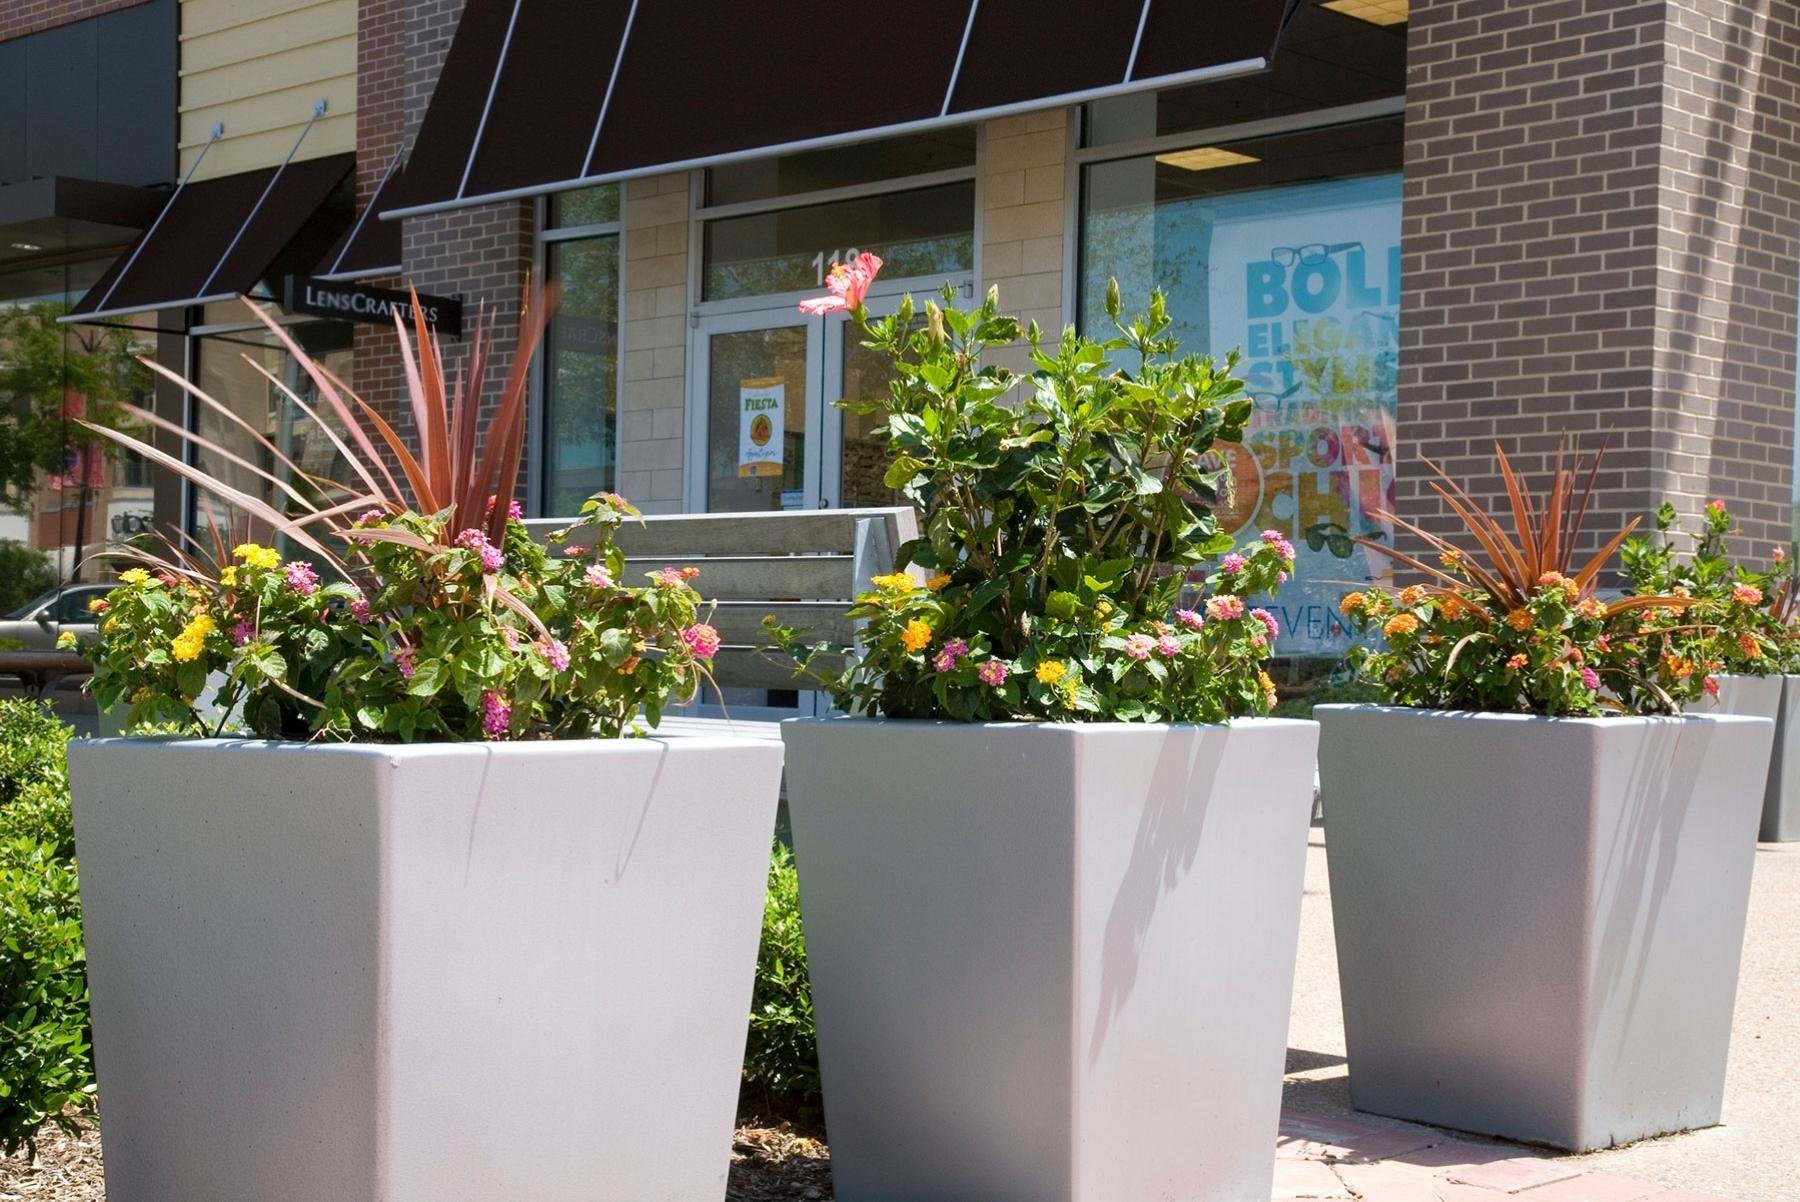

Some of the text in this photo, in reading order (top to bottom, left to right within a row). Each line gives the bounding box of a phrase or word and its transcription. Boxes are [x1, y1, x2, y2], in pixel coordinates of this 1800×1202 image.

[1247, 245, 1401, 319] BOL
[744, 398, 778, 411] FIESTA
[1188, 448, 1238, 471] AVE
[1254, 467, 1396, 541] CHI
